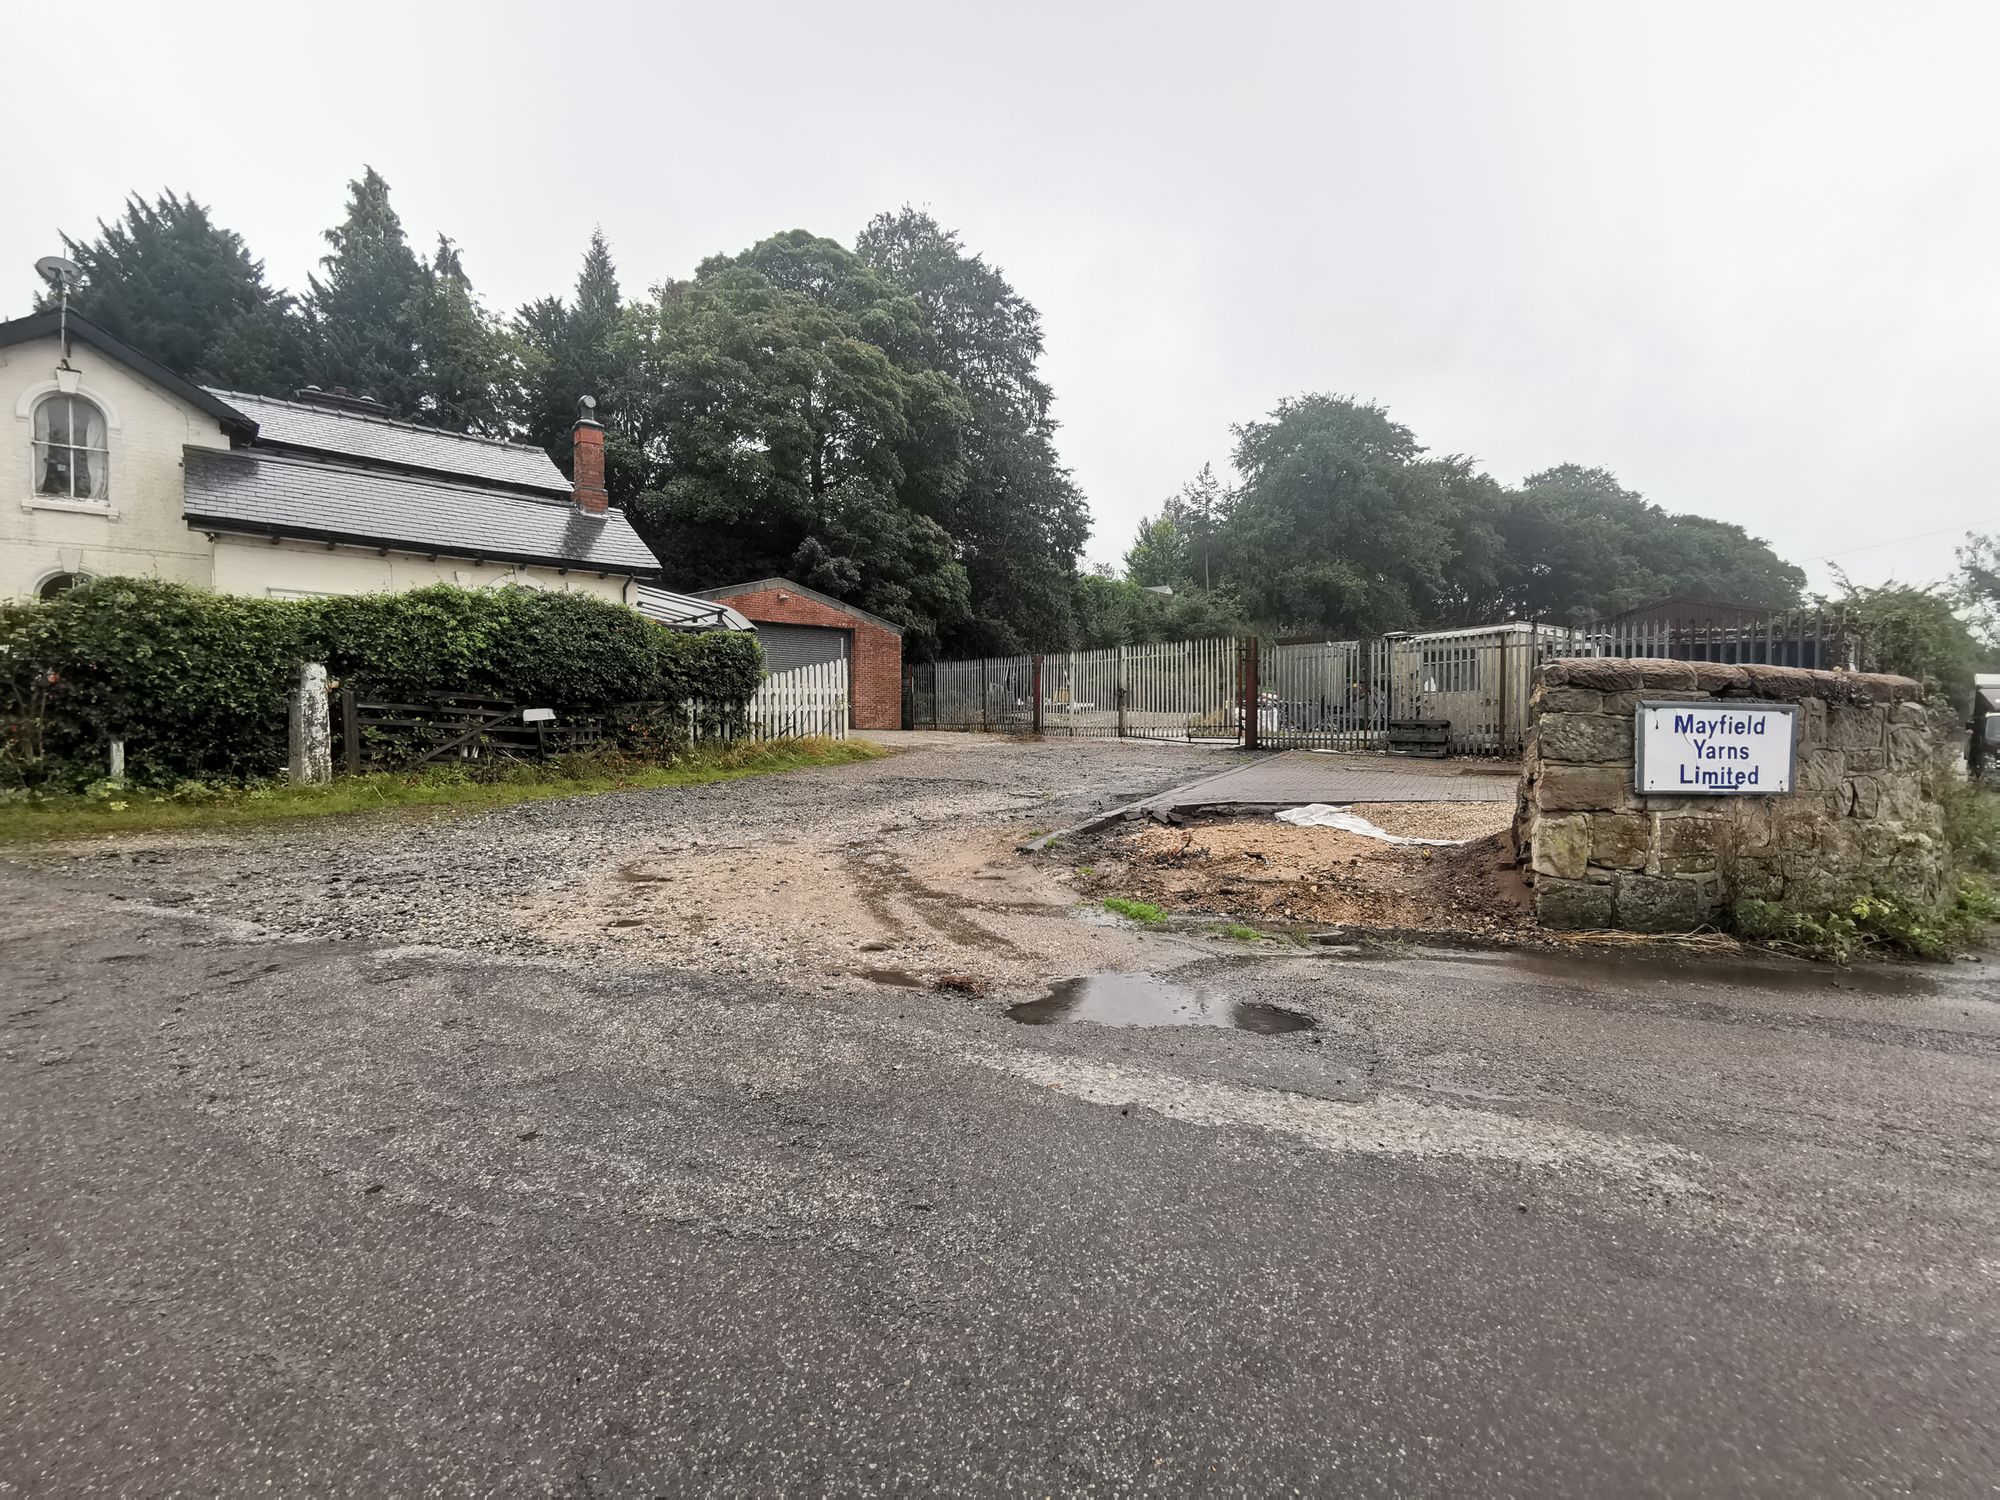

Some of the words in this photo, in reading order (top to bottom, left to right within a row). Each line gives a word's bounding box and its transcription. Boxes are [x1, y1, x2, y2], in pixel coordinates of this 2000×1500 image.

[1674, 713, 1766, 739] Mayfield
[1693, 739, 1750, 760] Yarns
[1680, 764, 1759, 785] Limited
